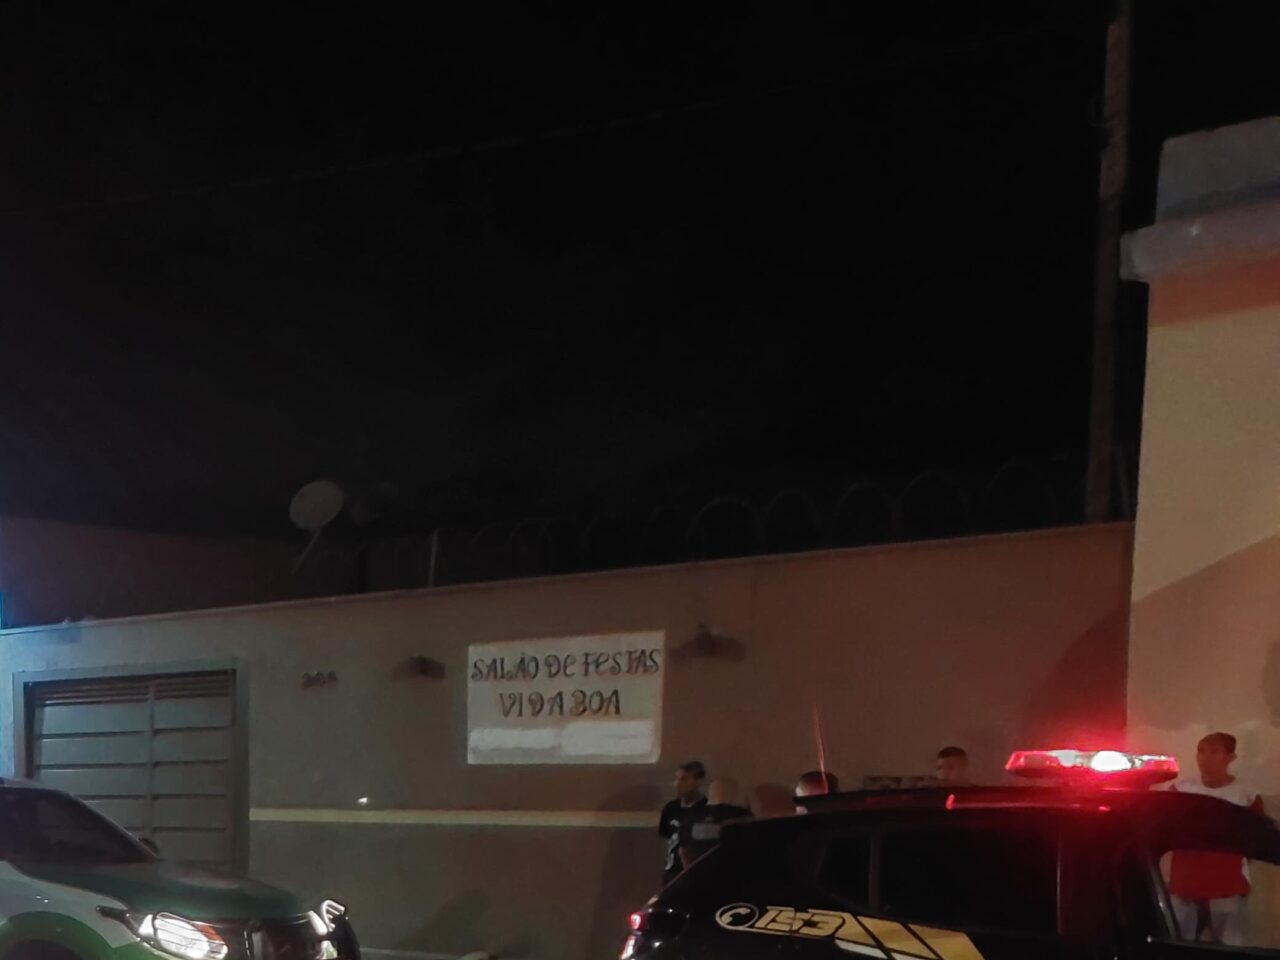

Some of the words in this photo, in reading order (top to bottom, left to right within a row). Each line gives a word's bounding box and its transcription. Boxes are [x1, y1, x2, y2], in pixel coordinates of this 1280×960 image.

[499, 691, 565, 718] VIDA
[570, 689, 621, 717] BOA
[753, 905, 847, 937] 153
